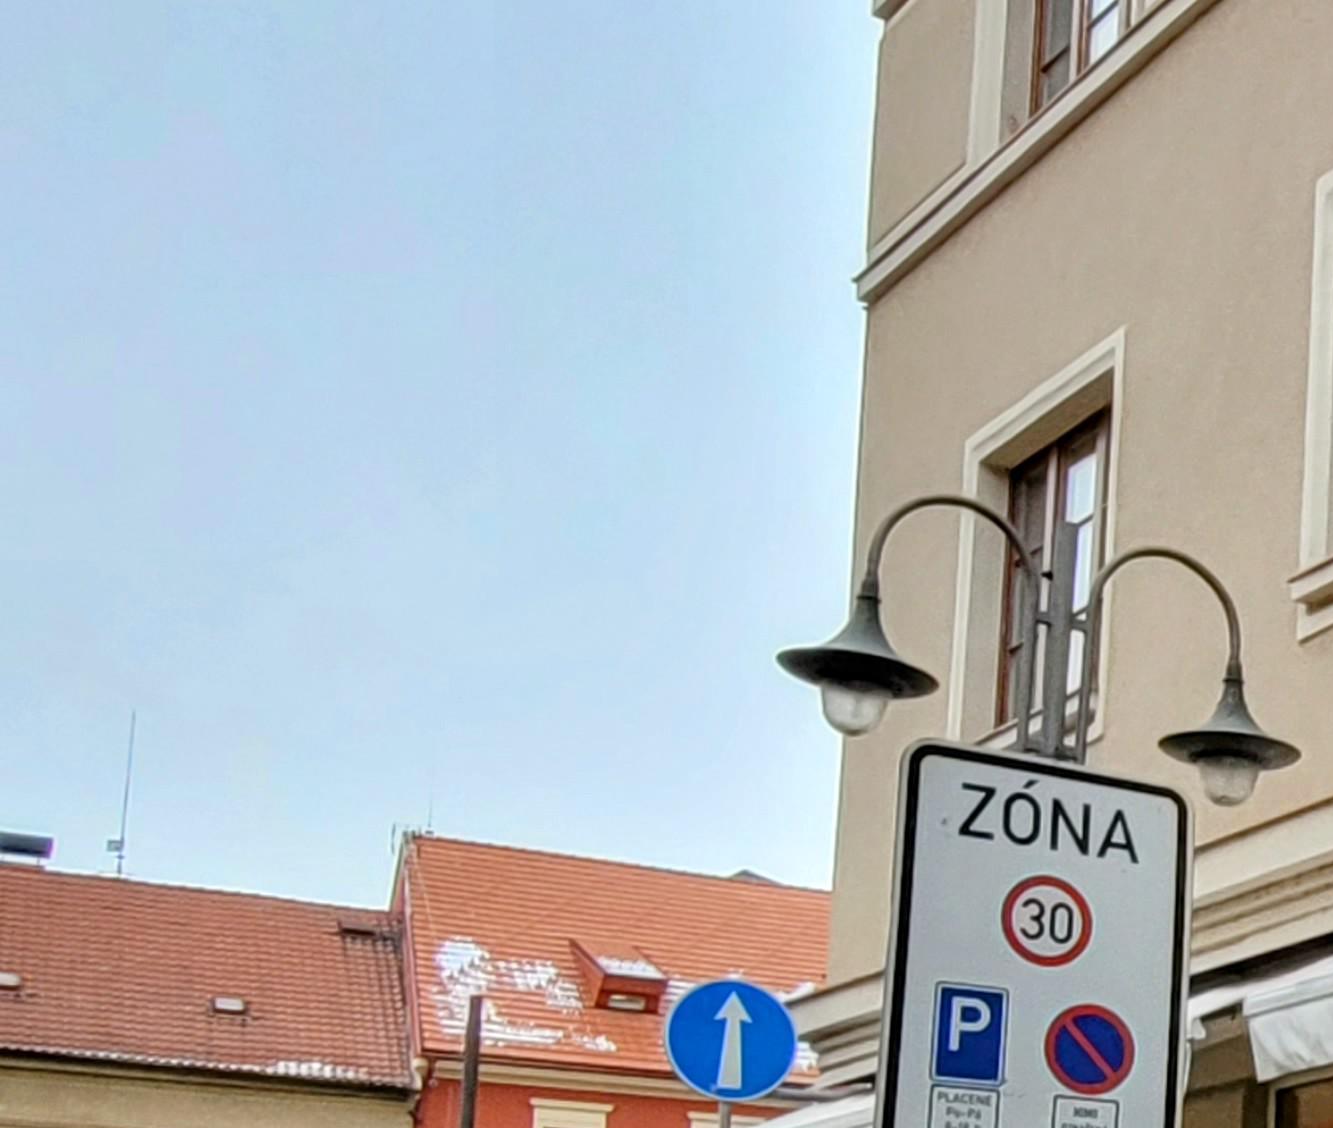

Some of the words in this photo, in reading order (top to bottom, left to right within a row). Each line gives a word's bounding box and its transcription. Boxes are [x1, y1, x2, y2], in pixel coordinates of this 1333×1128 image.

[958, 779, 1139, 864] ZÓNA
[1019, 898, 1074, 944] 30
[948, 996, 991, 1051] P
